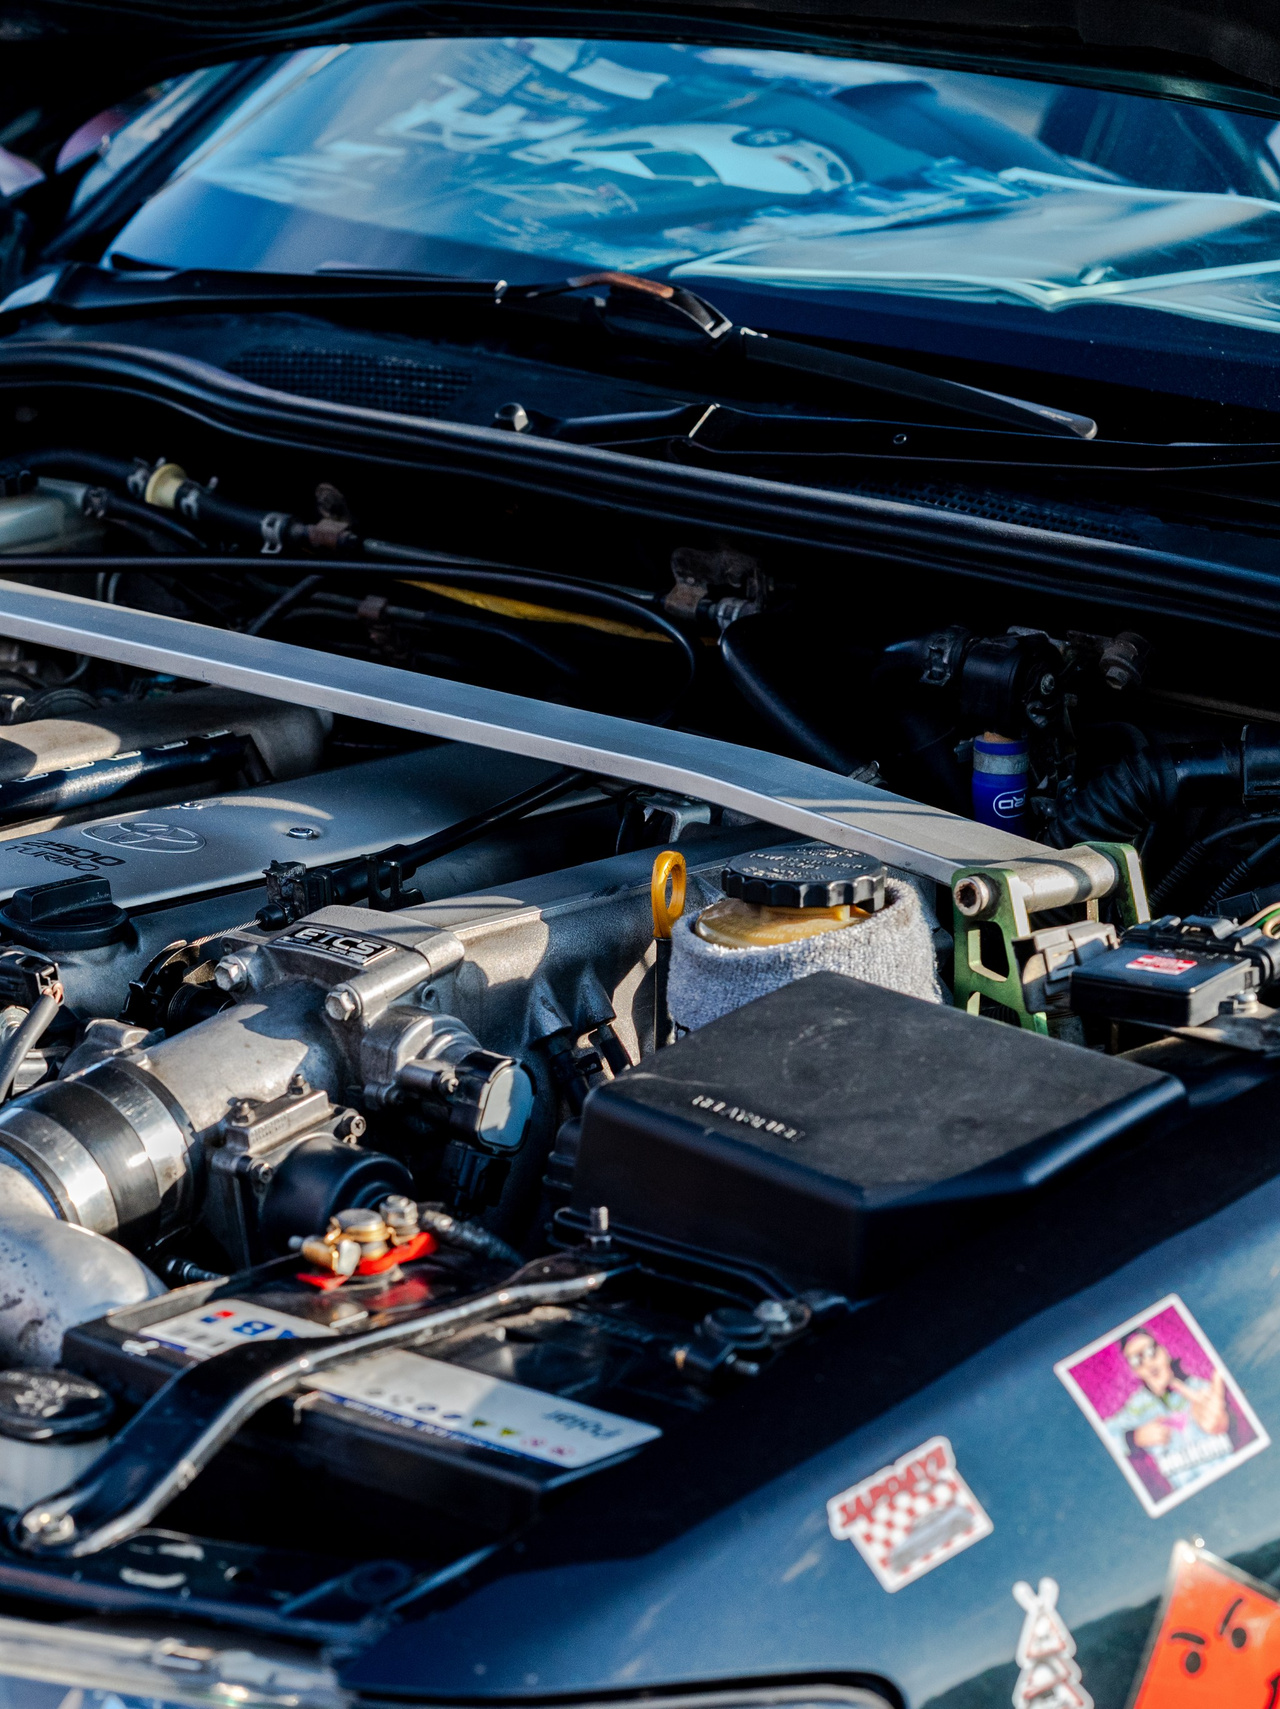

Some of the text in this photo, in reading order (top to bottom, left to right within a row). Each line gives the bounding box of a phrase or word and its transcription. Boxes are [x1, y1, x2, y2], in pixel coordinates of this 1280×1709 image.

[4, 844, 100, 872] TURBO
[22, 838, 126, 867] 2500
[294, 927, 382, 955] ETCS
